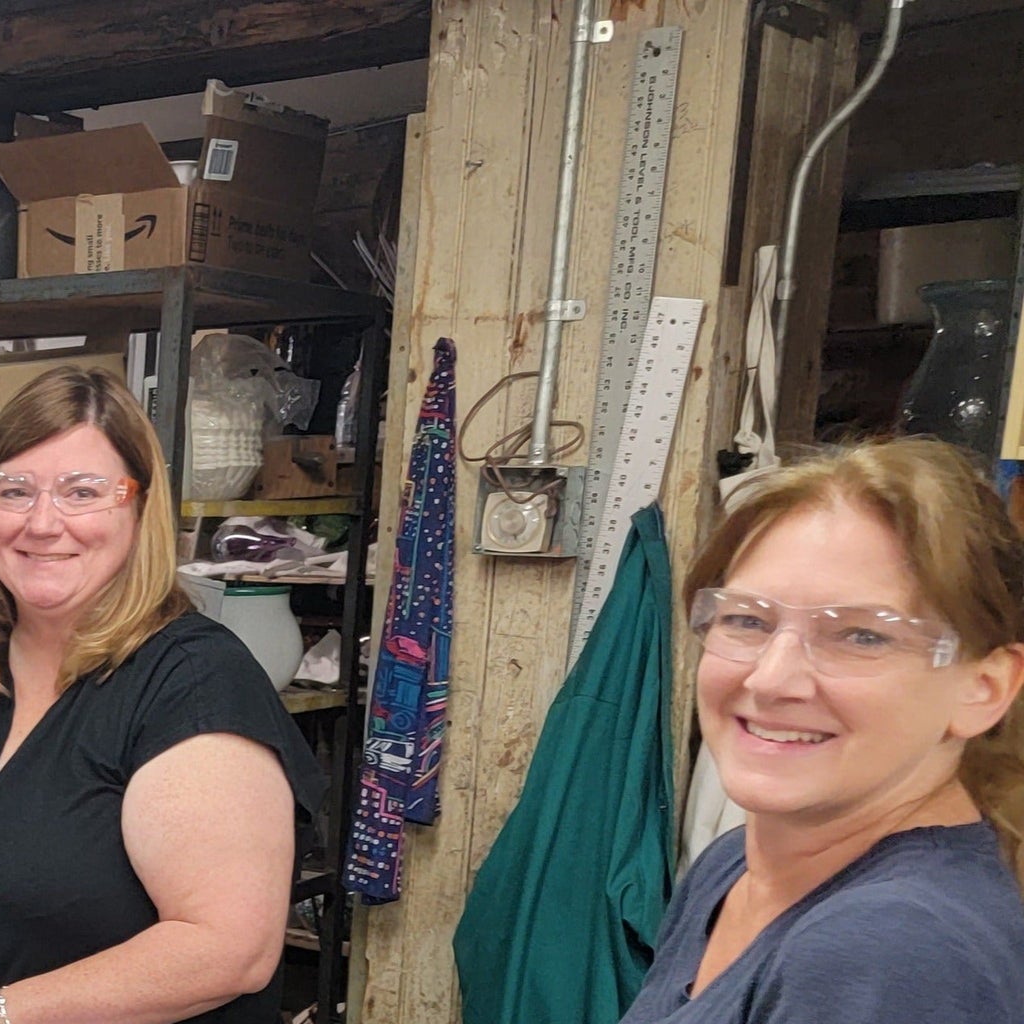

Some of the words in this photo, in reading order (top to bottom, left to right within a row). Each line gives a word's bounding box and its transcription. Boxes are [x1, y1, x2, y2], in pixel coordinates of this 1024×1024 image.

[637, 153, 647, 192] LEVEL
[622, 215, 629, 228] 40
[631, 209, 641, 242] TOOL
[86, 234, 94, 258] small
[96, 240, 103, 249] to
[638, 263, 646, 274] 10
[636, 286, 643, 296] 11
[620, 308, 629, 333] INC.
[633, 310, 640, 320] 12
[656, 312, 665, 325] 47
[630, 334, 637, 343] 13
[650, 335, 660, 348] 46
[606, 356, 613, 367] 34
[627, 357, 634, 367] 14
[645, 359, 654, 372] 45
[603, 379, 611, 390] 33
[639, 382, 648, 395] 44
[634, 405, 643, 418] 43
[598, 425, 606, 436] 31
[629, 428, 638, 441] 42
[623, 452, 632, 464] 41
[618, 474, 627, 487] 40
[613, 496, 622, 509] 39
[602, 542, 612, 554] 37
